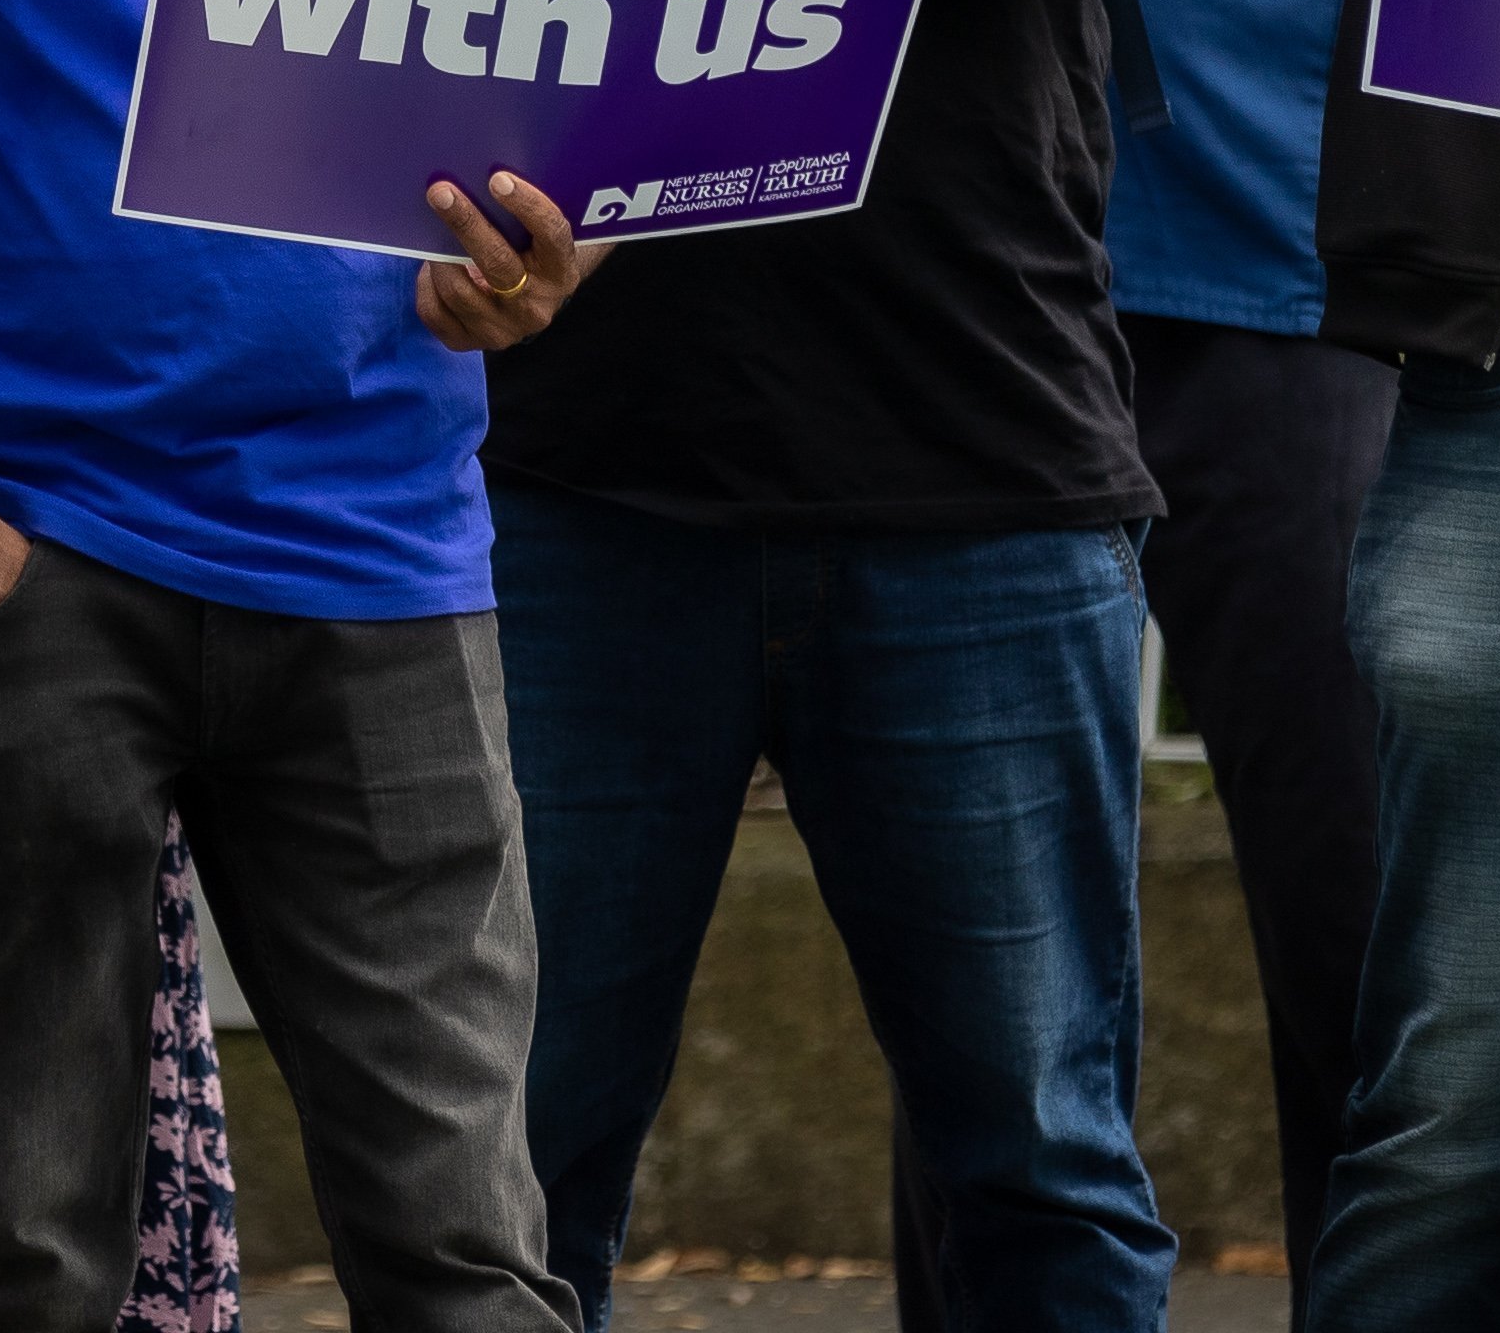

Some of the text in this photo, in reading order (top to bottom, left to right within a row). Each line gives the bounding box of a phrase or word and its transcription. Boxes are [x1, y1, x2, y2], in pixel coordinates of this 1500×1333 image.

[768, 151, 850, 174] TŌPŪTANGA
[666, 167, 753, 188] NEW ZEALAND
[764, 165, 848, 193] TAPUHI
[661, 179, 750, 204] NURSES
[792, 190, 799, 198] O
[799, 183, 843, 196] AOTEAROA
[657, 196, 745, 215] ORGANISATION
